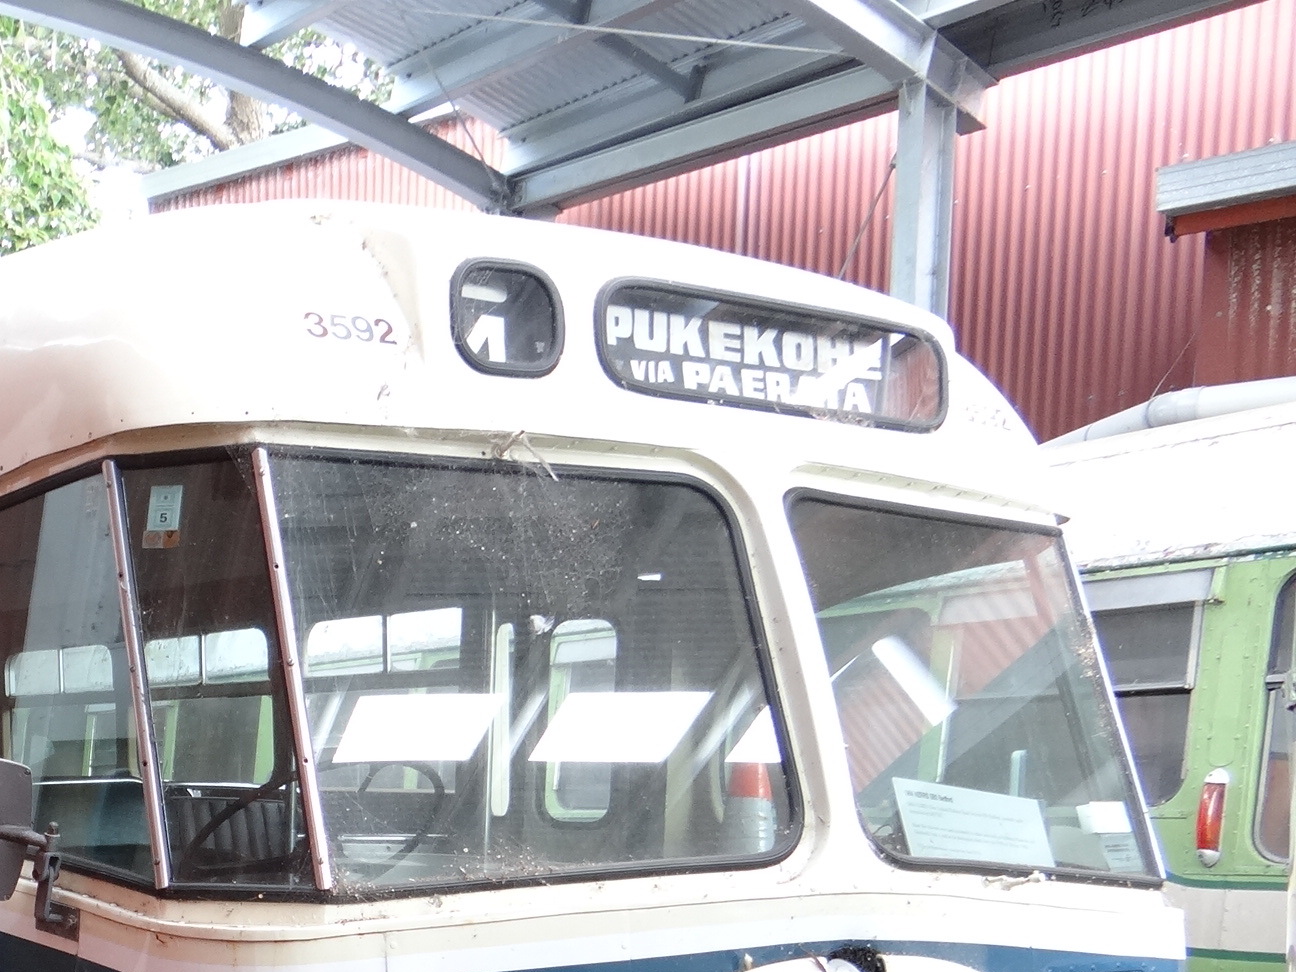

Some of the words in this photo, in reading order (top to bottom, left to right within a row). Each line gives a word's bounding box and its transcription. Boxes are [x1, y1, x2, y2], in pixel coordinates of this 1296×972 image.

[304, 312, 398, 345] 3592
[630, 359, 675, 383] VIA
[159, 512, 168, 523] 5
